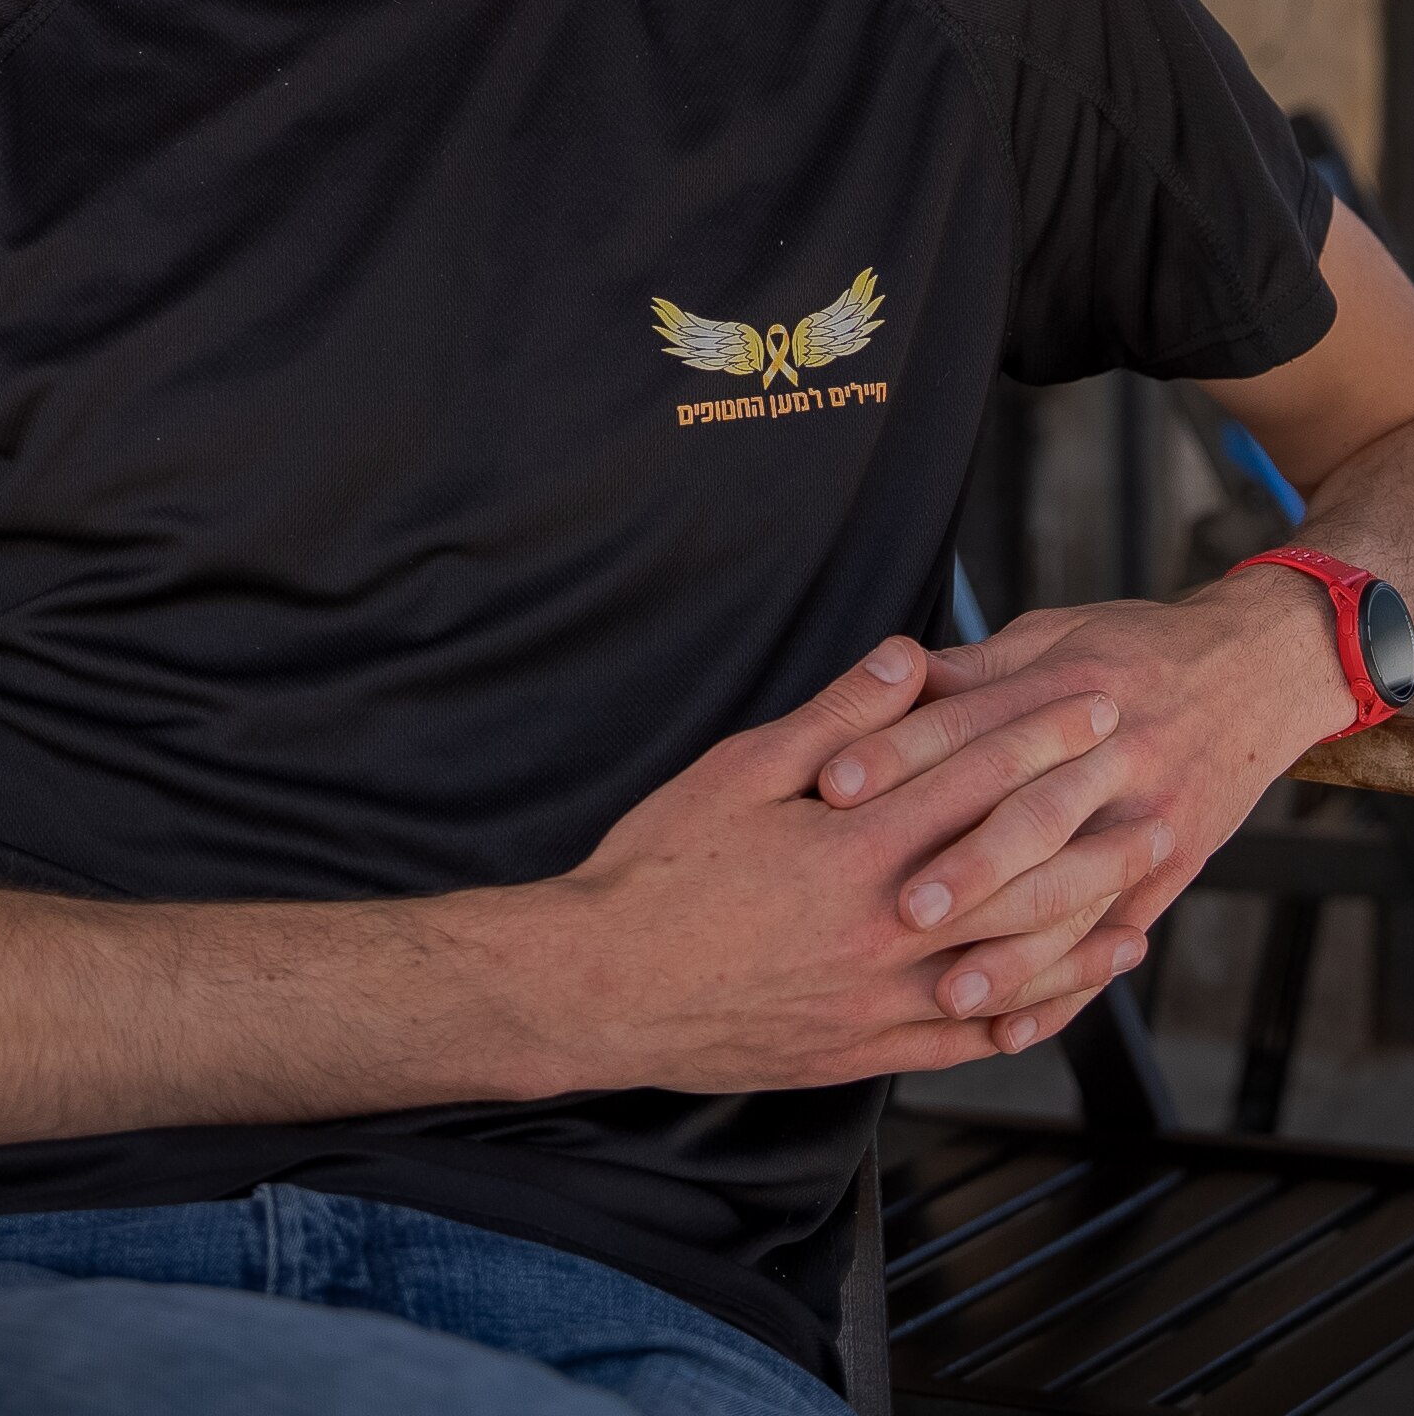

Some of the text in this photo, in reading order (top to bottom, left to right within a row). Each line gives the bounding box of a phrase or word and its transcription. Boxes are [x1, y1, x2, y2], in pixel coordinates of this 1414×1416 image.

[676, 382, 887, 426] חיילים למען החטופים
